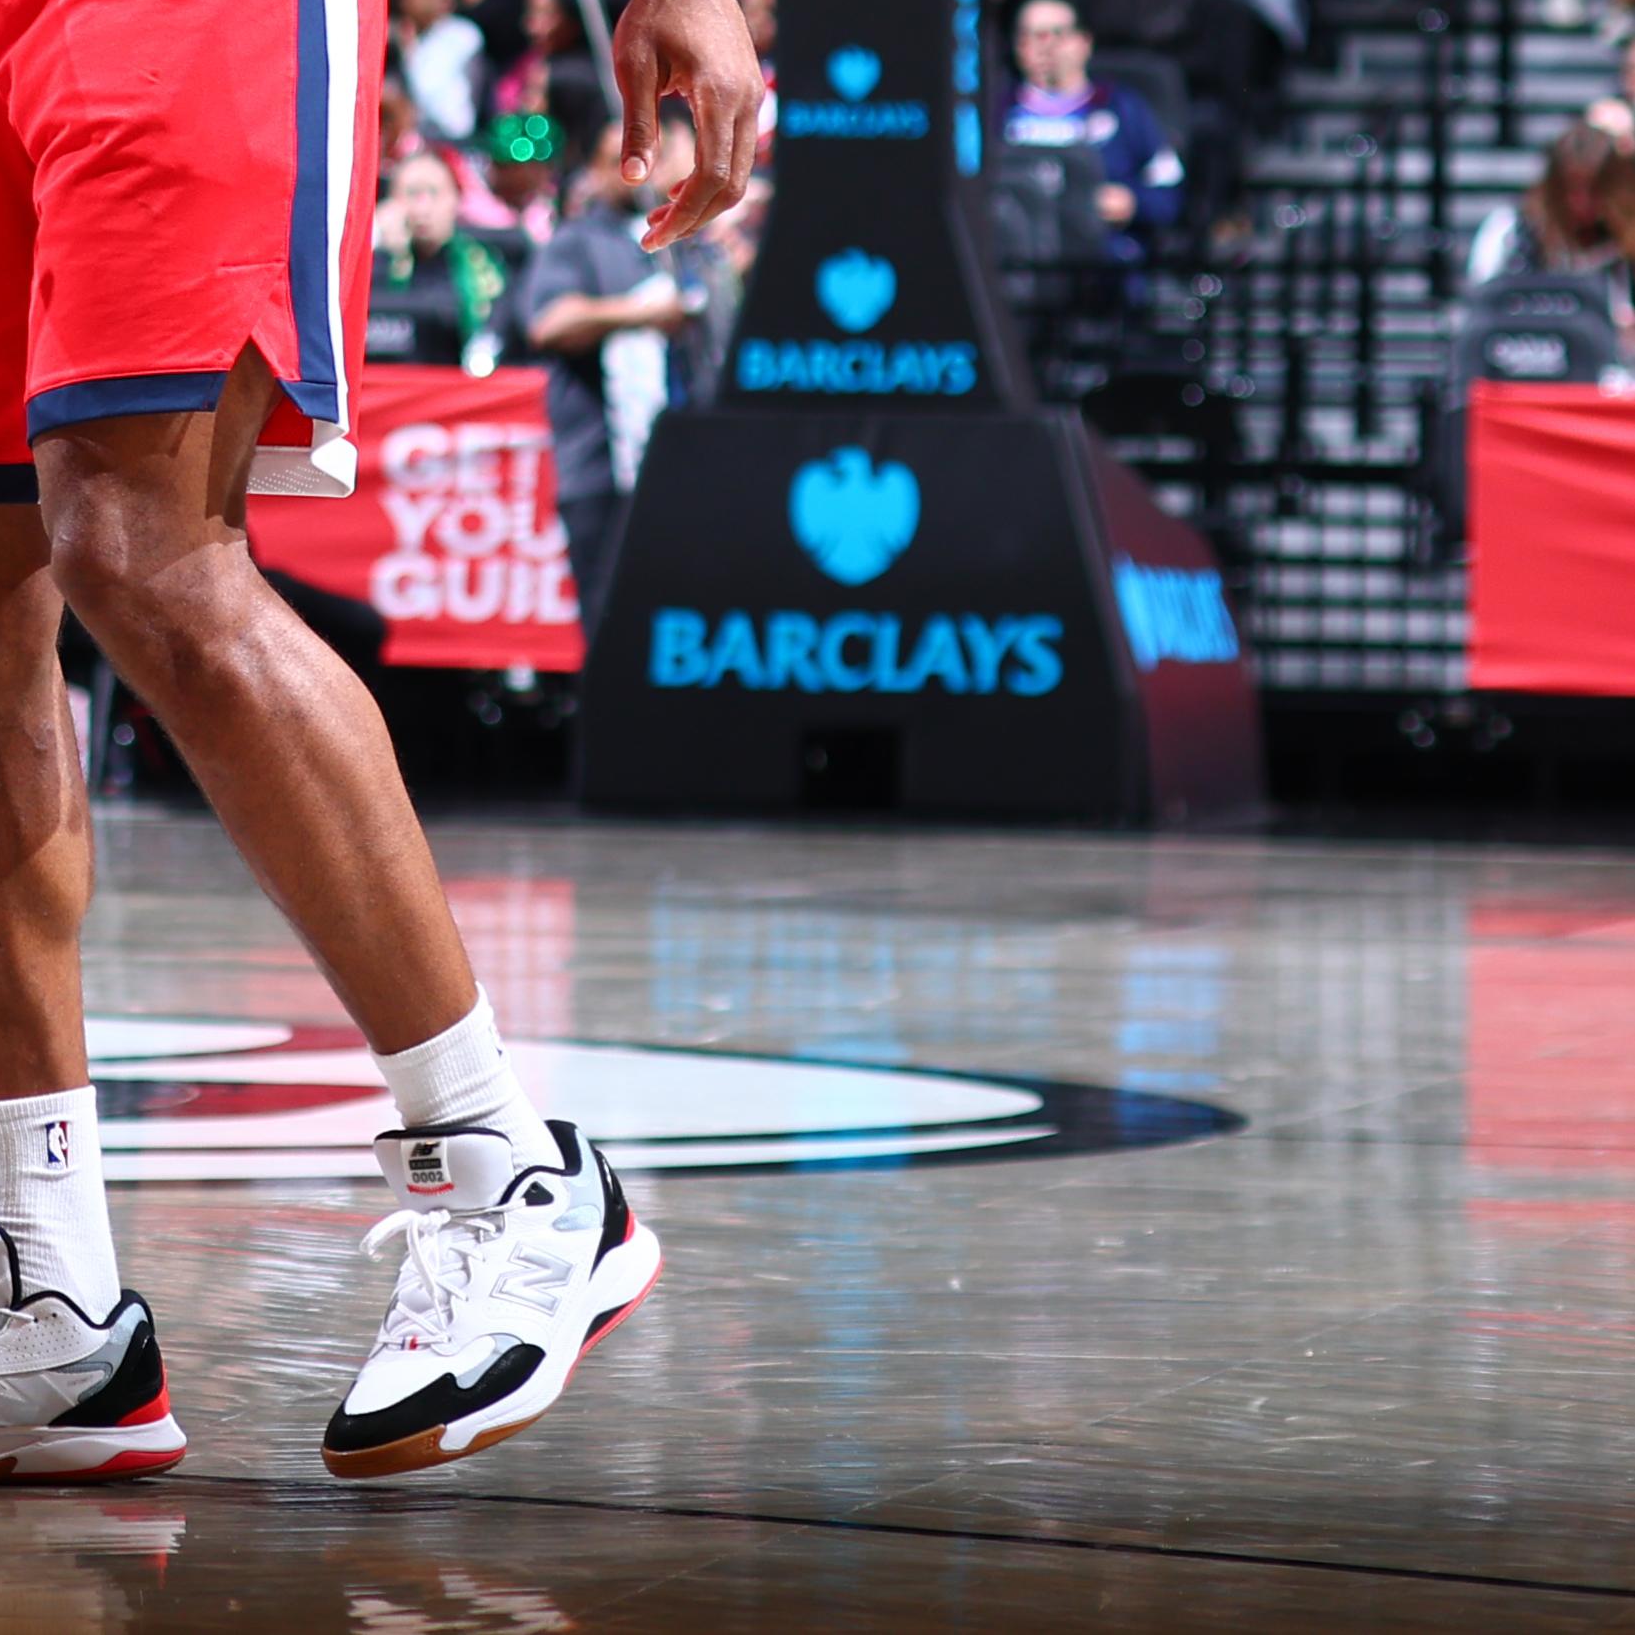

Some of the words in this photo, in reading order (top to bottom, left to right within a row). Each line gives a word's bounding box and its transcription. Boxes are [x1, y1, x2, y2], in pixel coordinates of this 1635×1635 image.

[783, 100, 928, 138] BARCLAYS
[737, 341, 977, 394] BARCLAYS
[382, 423, 554, 494] GET
[649, 608, 1064, 695] BARCLAYS
[412, 1171, 445, 1183] 0002
